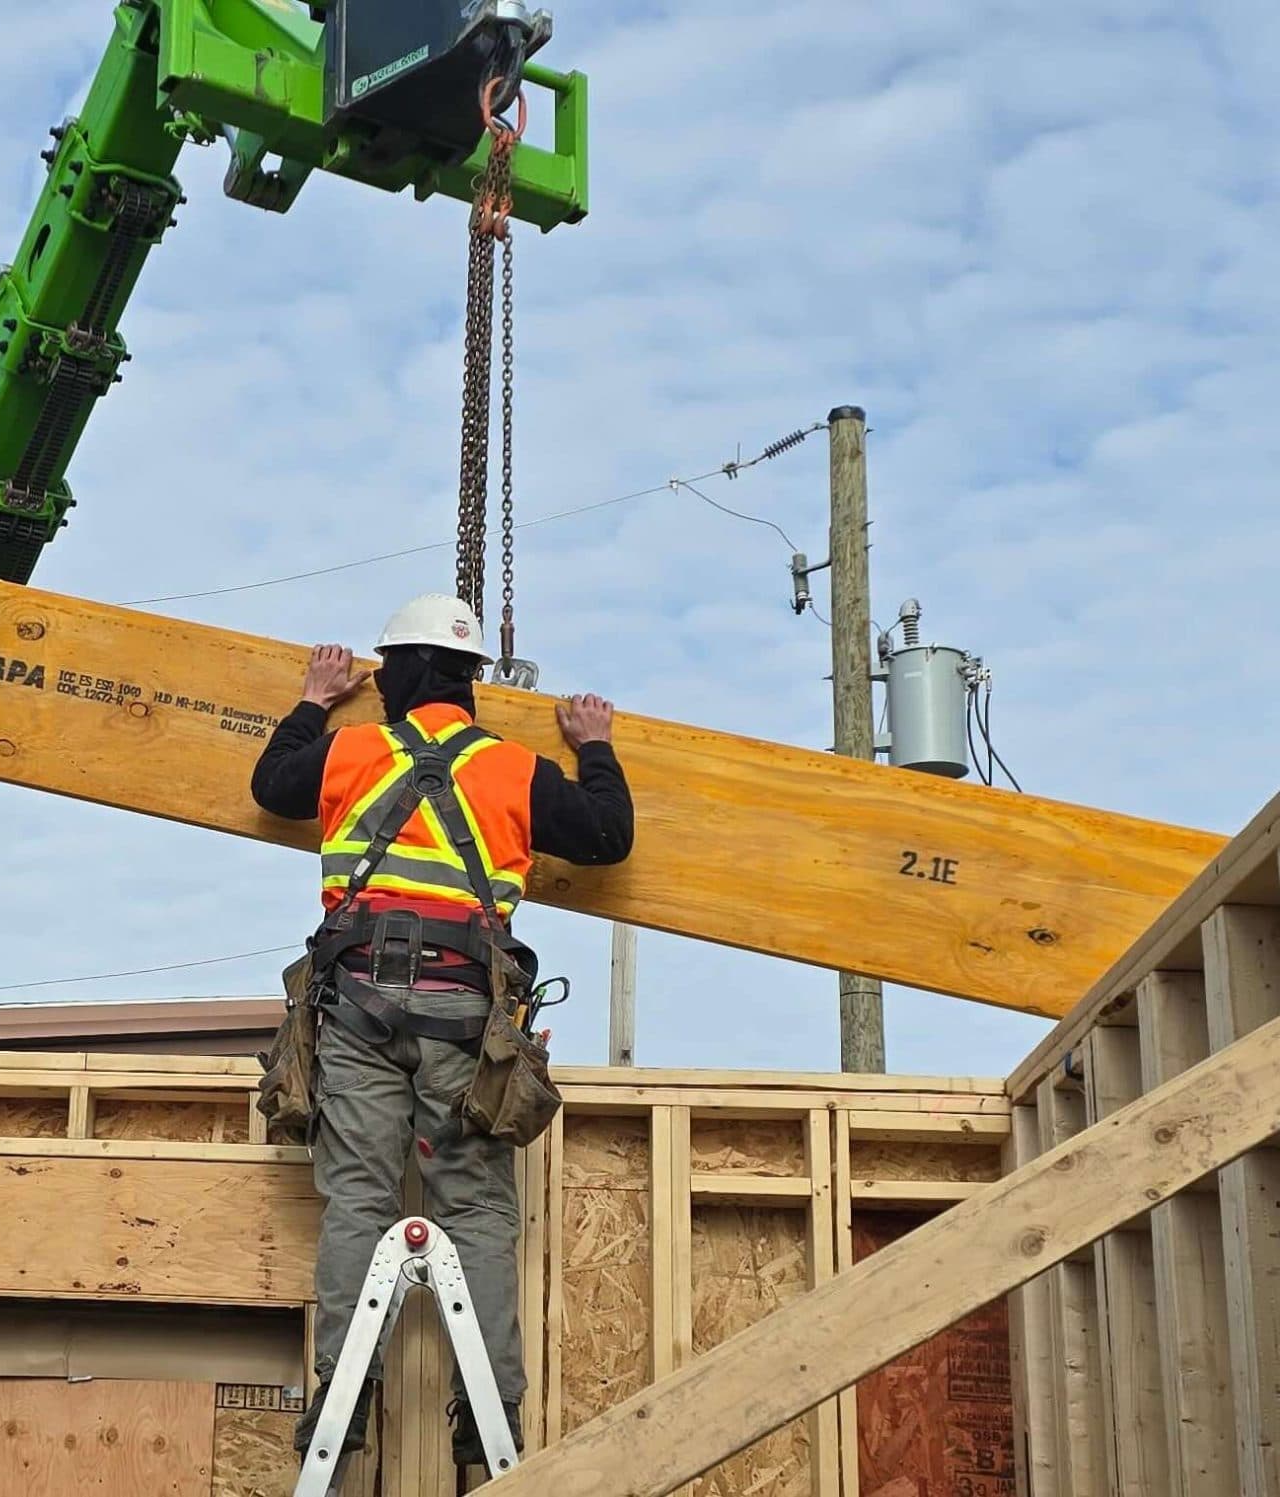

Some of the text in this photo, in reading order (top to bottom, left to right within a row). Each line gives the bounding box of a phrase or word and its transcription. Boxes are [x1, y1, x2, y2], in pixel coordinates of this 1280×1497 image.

[58, 669, 76, 684] ICC
[78, 675, 93, 688] ES
[95, 678, 114, 692] ESR
[153, 691, 173, 705] HUD
[220, 706, 279, 727] Alexandria
[220, 719, 267, 739] 01/15/26
[898, 850, 960, 885] 2.1E
